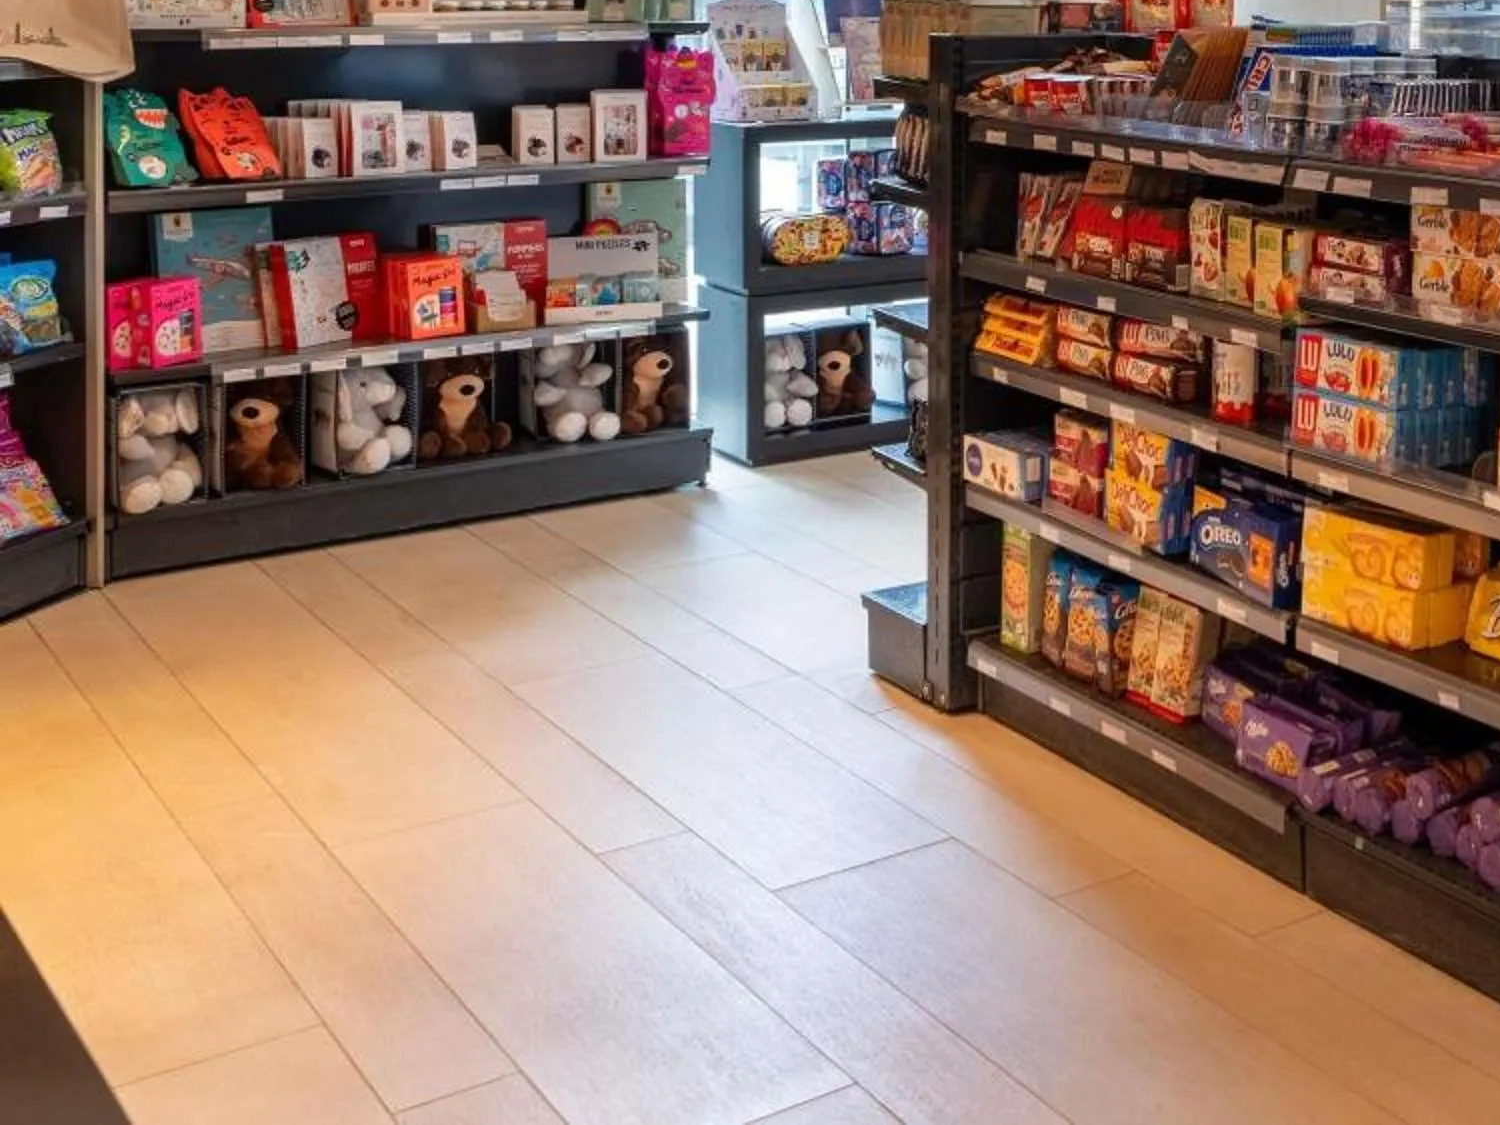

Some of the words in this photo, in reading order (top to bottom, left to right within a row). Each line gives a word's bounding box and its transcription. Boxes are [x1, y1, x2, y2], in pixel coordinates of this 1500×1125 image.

[1299, 341, 1319, 372] LU
[1296, 396, 1317, 429] LU
[1200, 523, 1242, 546] OREO
